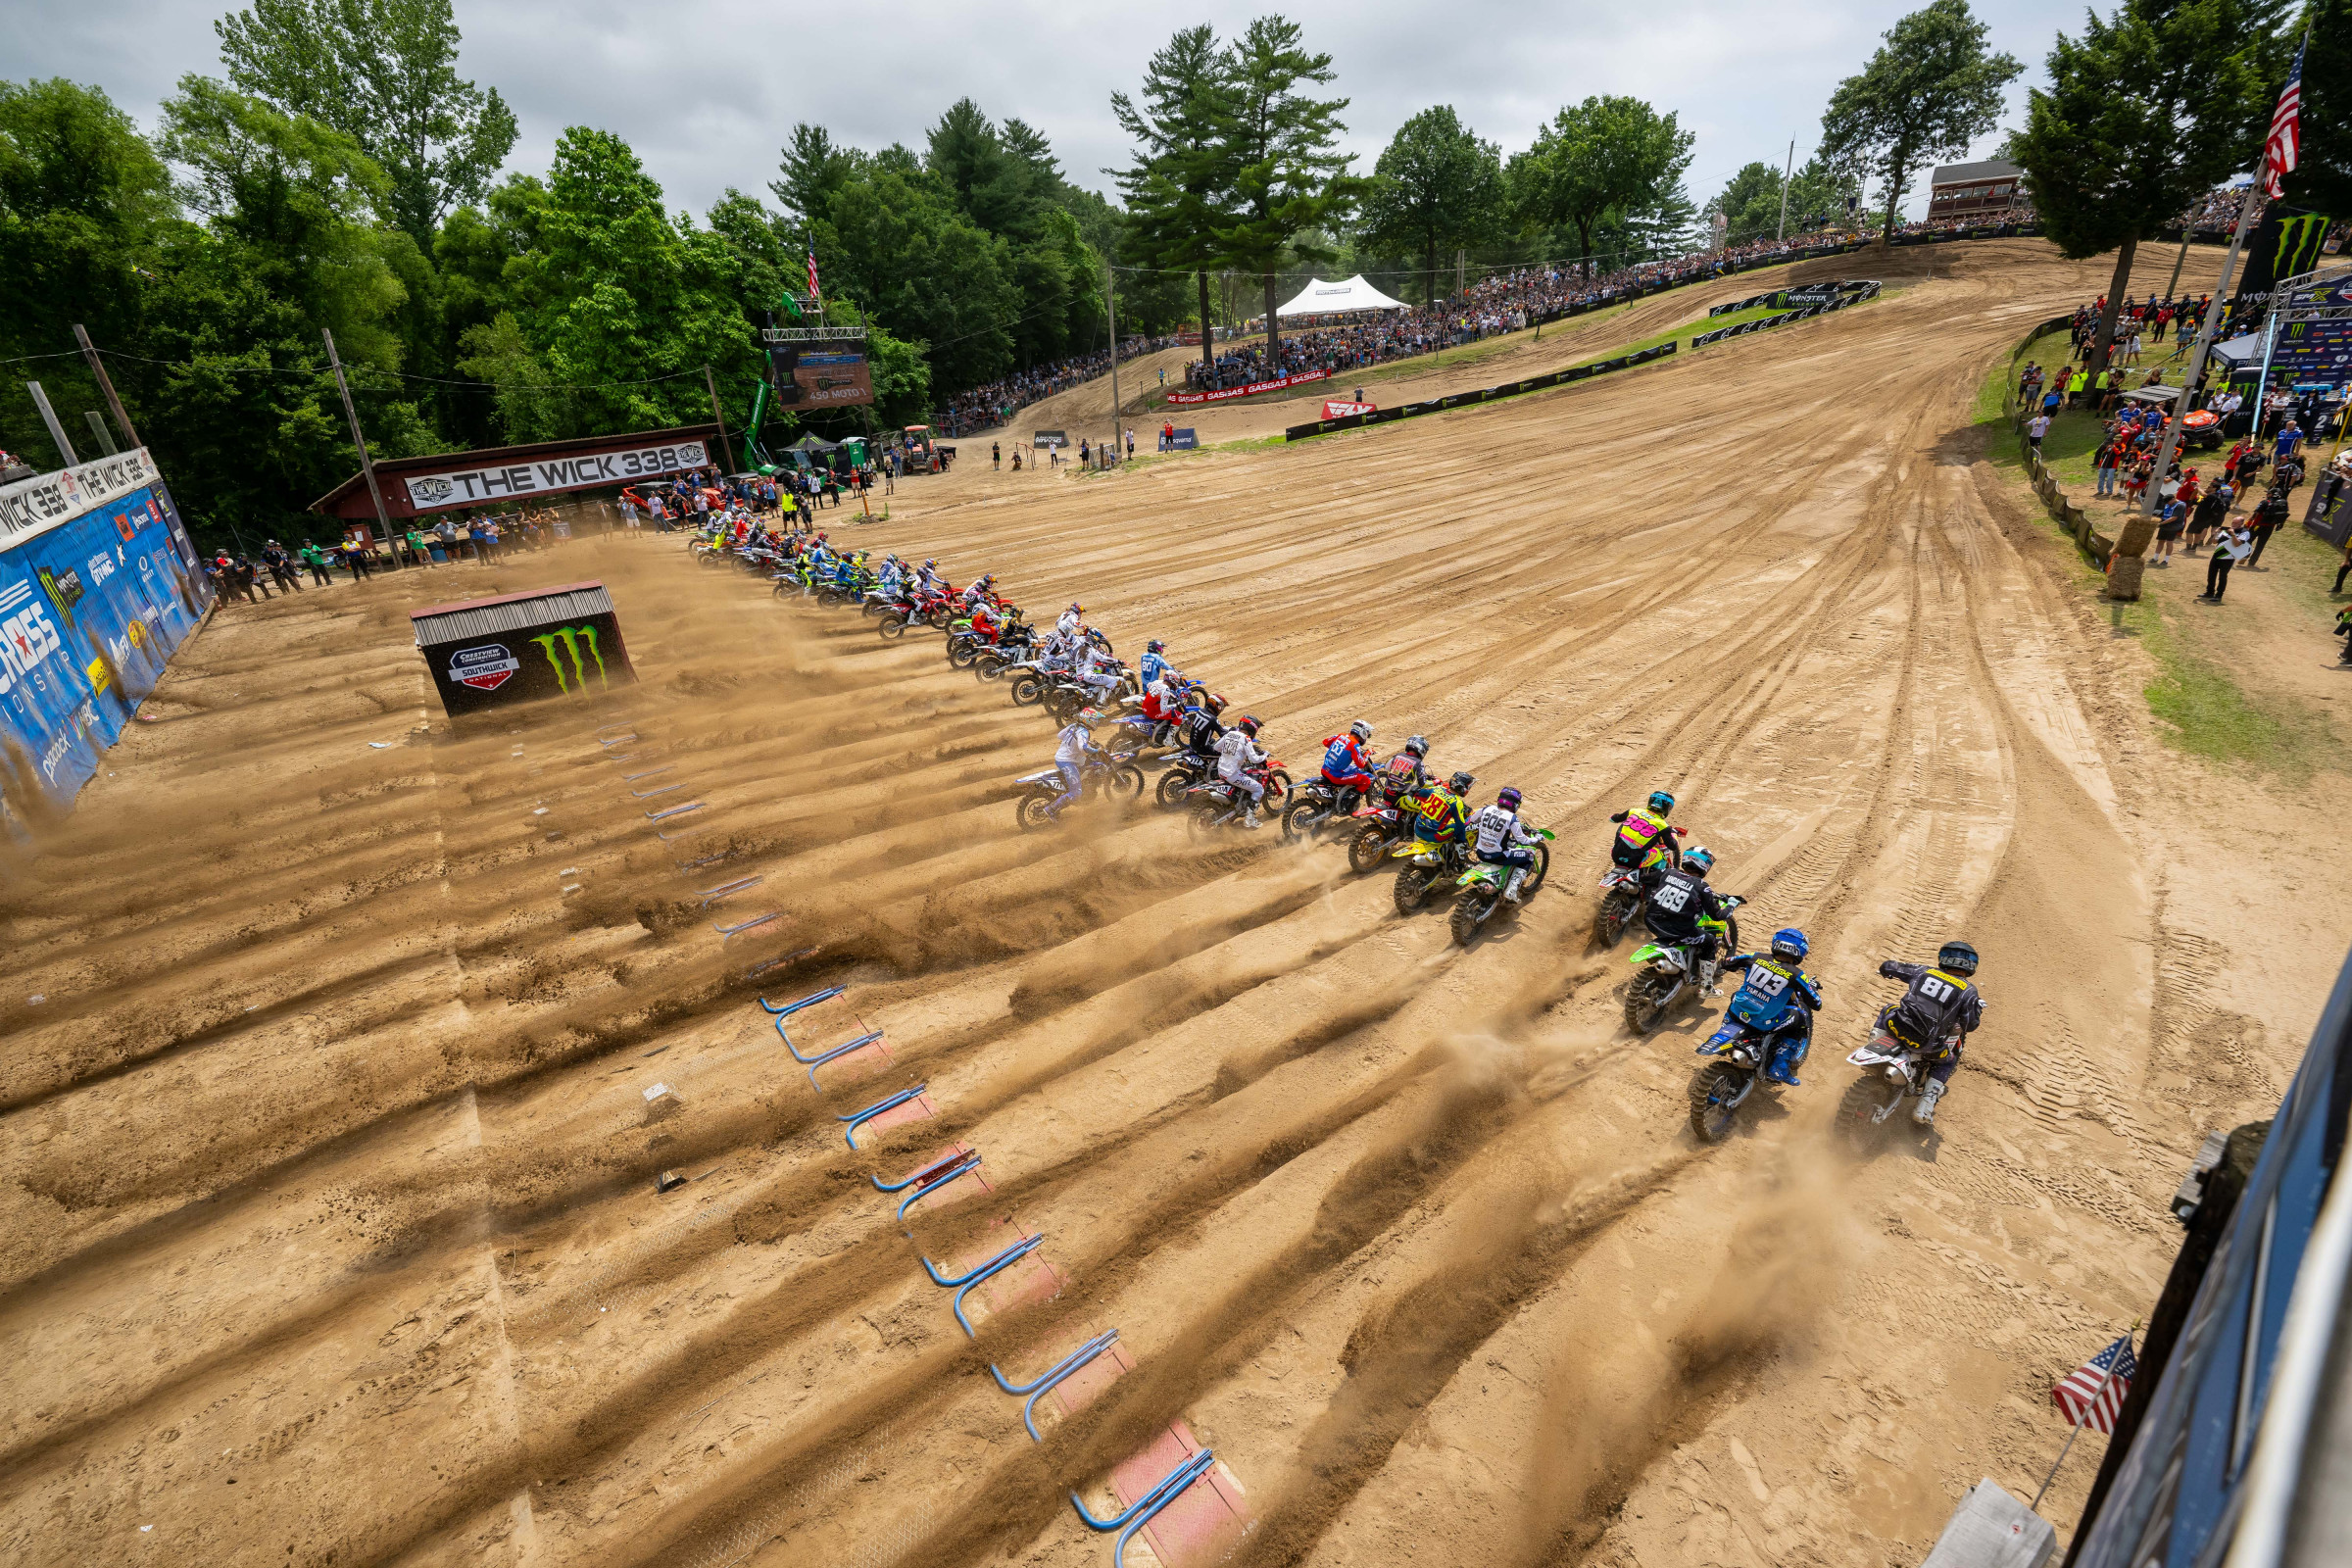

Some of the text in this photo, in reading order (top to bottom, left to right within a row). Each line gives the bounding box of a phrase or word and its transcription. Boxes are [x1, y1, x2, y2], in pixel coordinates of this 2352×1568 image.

[1788, 294, 1827, 303] MONSTER
[809, 390, 829, 401] 450
[831, 387, 859, 399] MOTO
[1178, 394, 1204, 403] GASGAS
[1207, 387, 1244, 400] GASGAS
[1248, 378, 1288, 392] GASGAS
[1291, 370, 1325, 384] GASGAS
[1327, 402, 1373, 416] FLY
[2314, 415, 2328, 429] 2
[76, 458, 145, 500] THE WICK 338
[452, 447, 680, 499] THE WICK 338
[411, 481, 452, 496] THE WICK
[31, 483, 69, 518] 338
[460, 648, 500, 661] CRESTVIEW
[461, 652, 501, 663] CONSTRUCTION
[462, 662, 509, 677] SOUTHWICK
[468, 672, 508, 683] NATIONAL
[42, 727, 73, 788] peacock
[1420, 793, 1450, 823] 281
[1482, 811, 1507, 833] 206
[1653, 883, 1691, 913] 489
[1754, 957, 1793, 980] VERHAEGHE
[1745, 962, 1789, 998] 103
[1920, 976, 1955, 1004] 81
[1745, 985, 1773, 1004] YAMAHA
